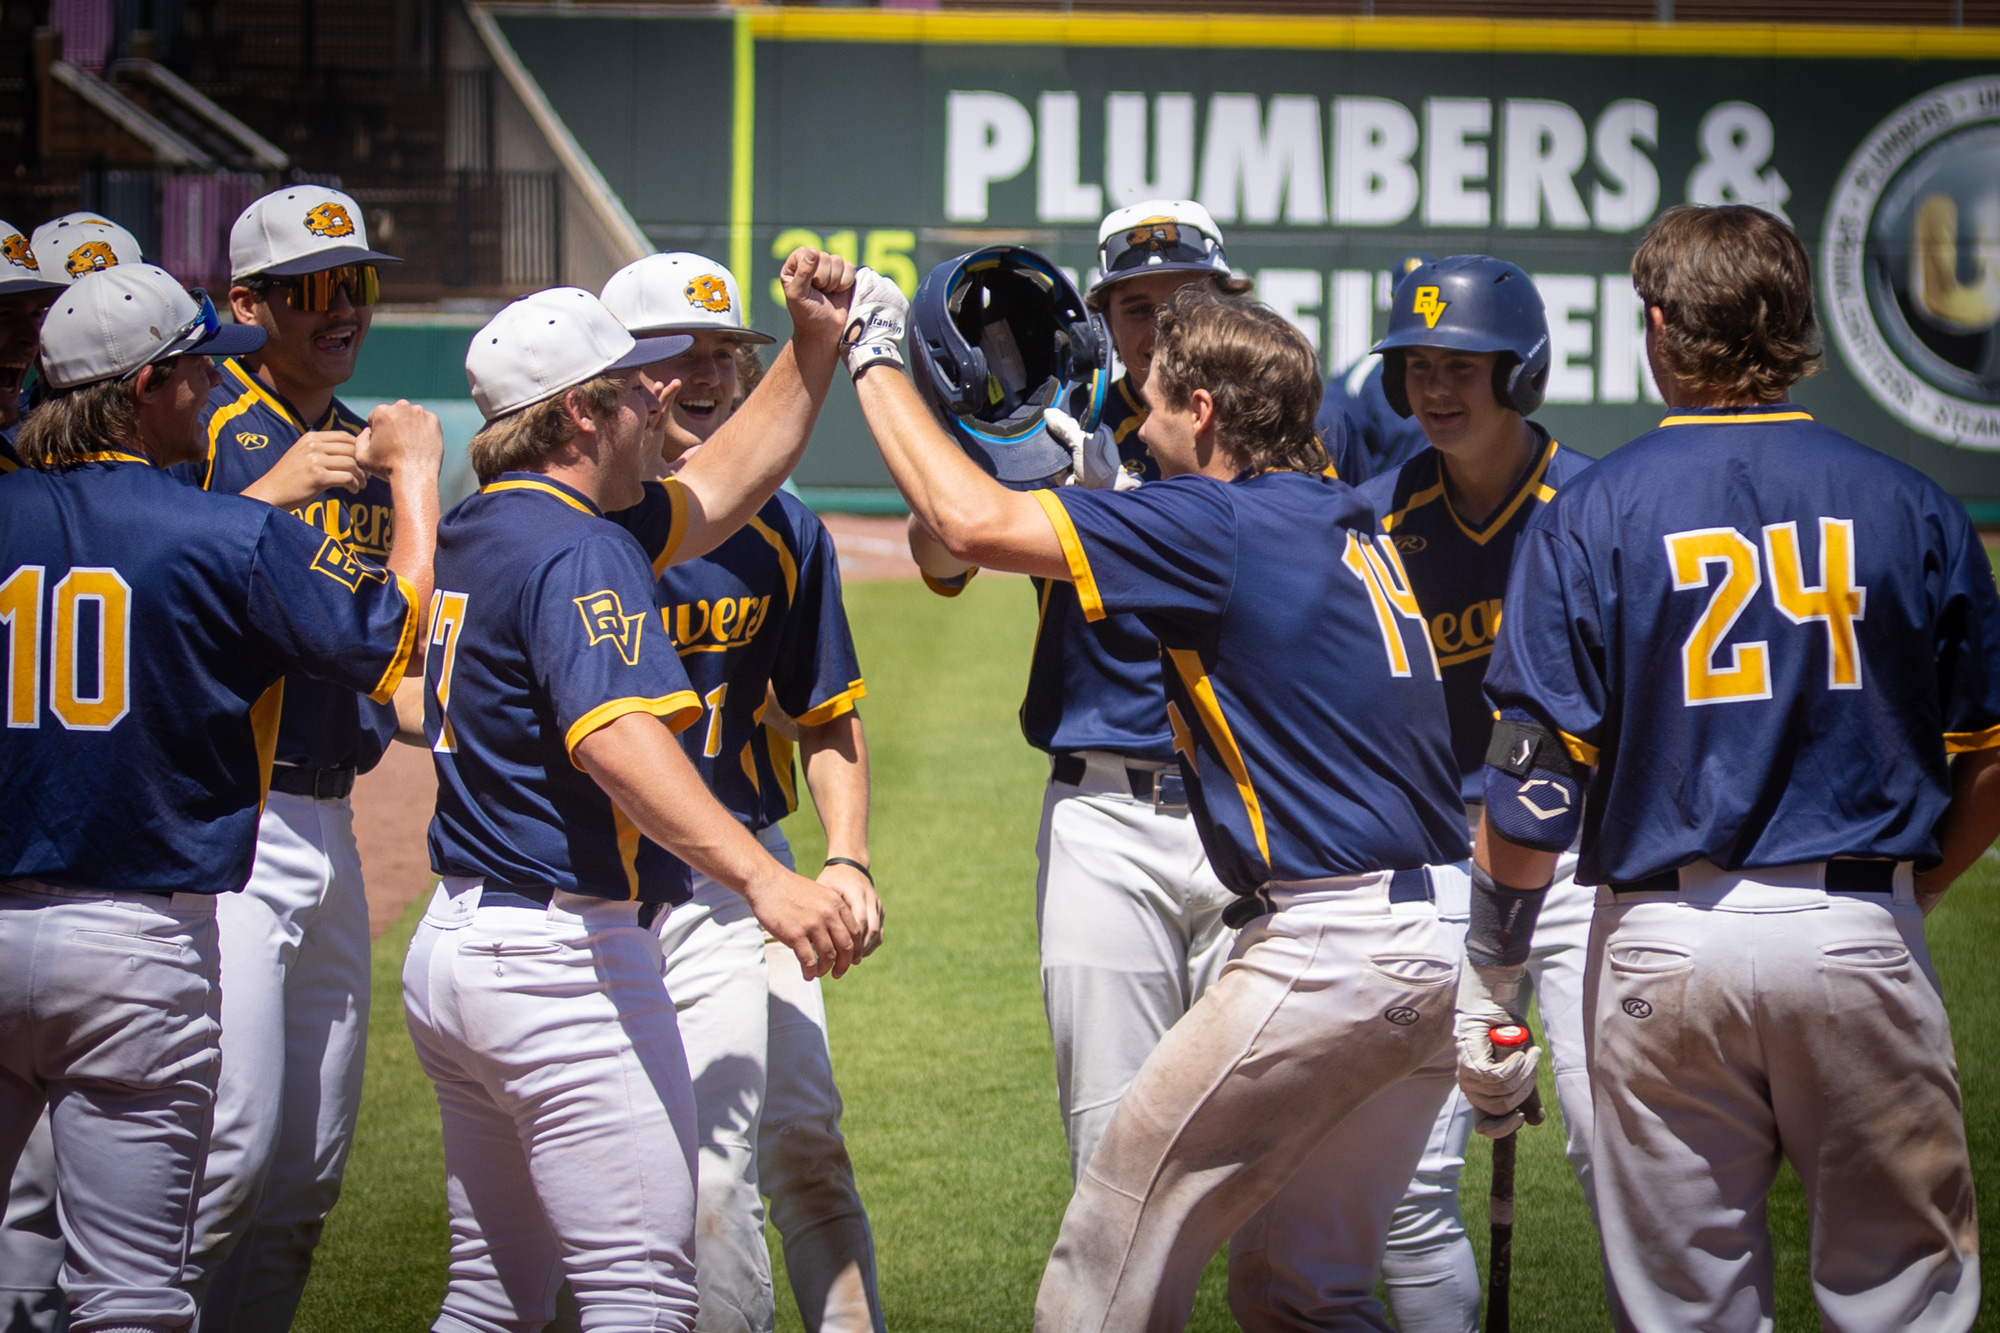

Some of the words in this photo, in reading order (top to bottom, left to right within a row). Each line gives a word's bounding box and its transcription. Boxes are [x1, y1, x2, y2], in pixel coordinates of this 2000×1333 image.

[944, 90, 1661, 232] PLUMBERS
[1686, 101, 1794, 227] &
[1413, 286, 1447, 329] BV
[0, 565, 133, 732] 10
[572, 589, 648, 665] BV
[660, 595, 771, 647] vers
[1341, 528, 1443, 681] 14
[1663, 517, 1867, 707] 24
[703, 682, 729, 758] 1
